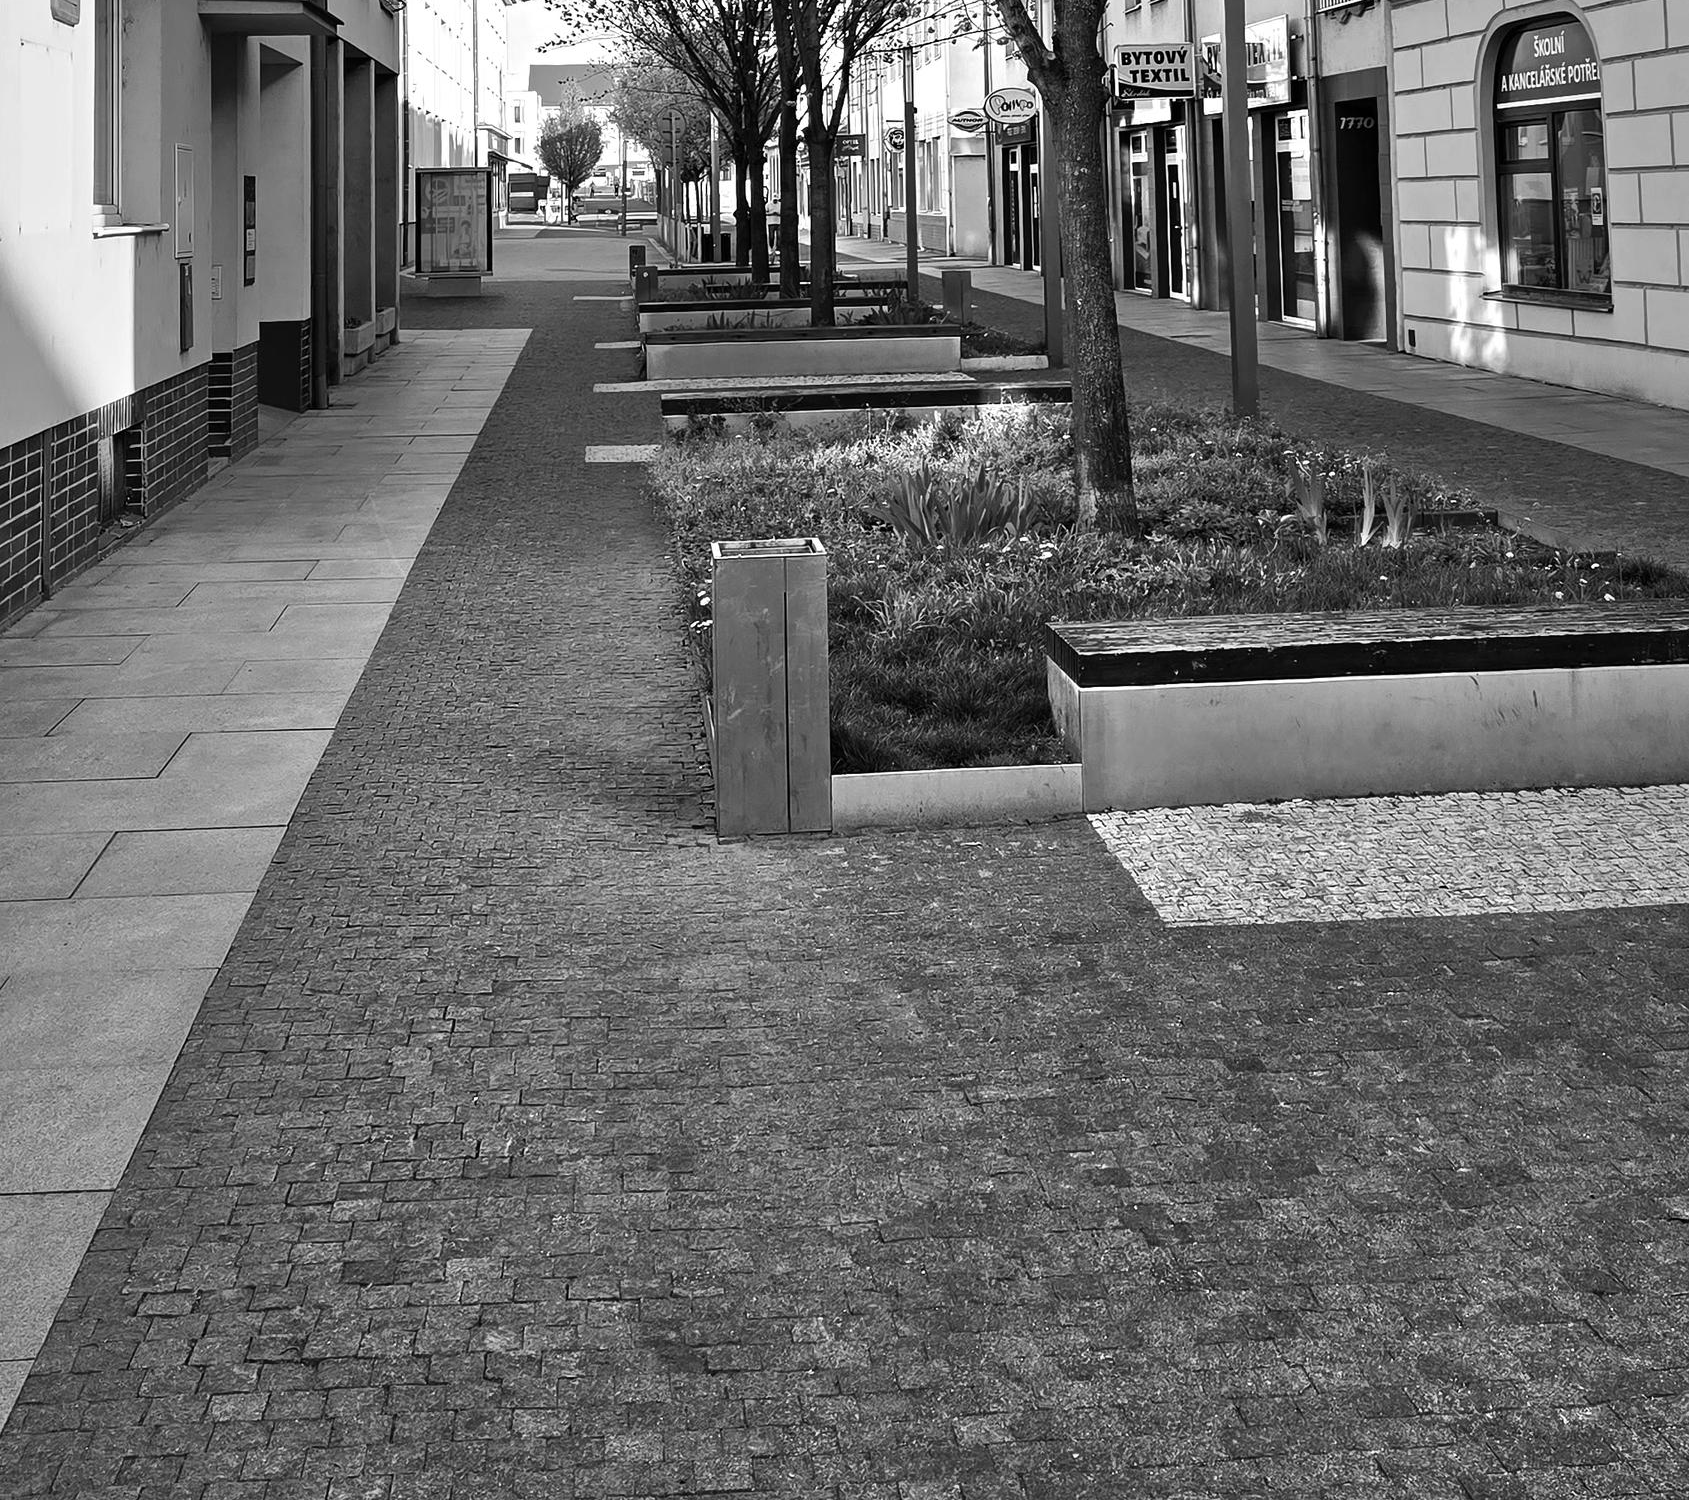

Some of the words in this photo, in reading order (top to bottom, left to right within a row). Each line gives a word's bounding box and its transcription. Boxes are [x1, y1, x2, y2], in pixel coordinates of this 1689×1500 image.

[1121, 46, 1188, 66] BYTOVÝ
[1533, 30, 1565, 58] ŠKOLNÍ
[1129, 68, 1190, 84] TEXTIL
[1501, 75, 1508, 92] A
[1508, 62, 1567, 92] KANCELÁŘSKÉ
